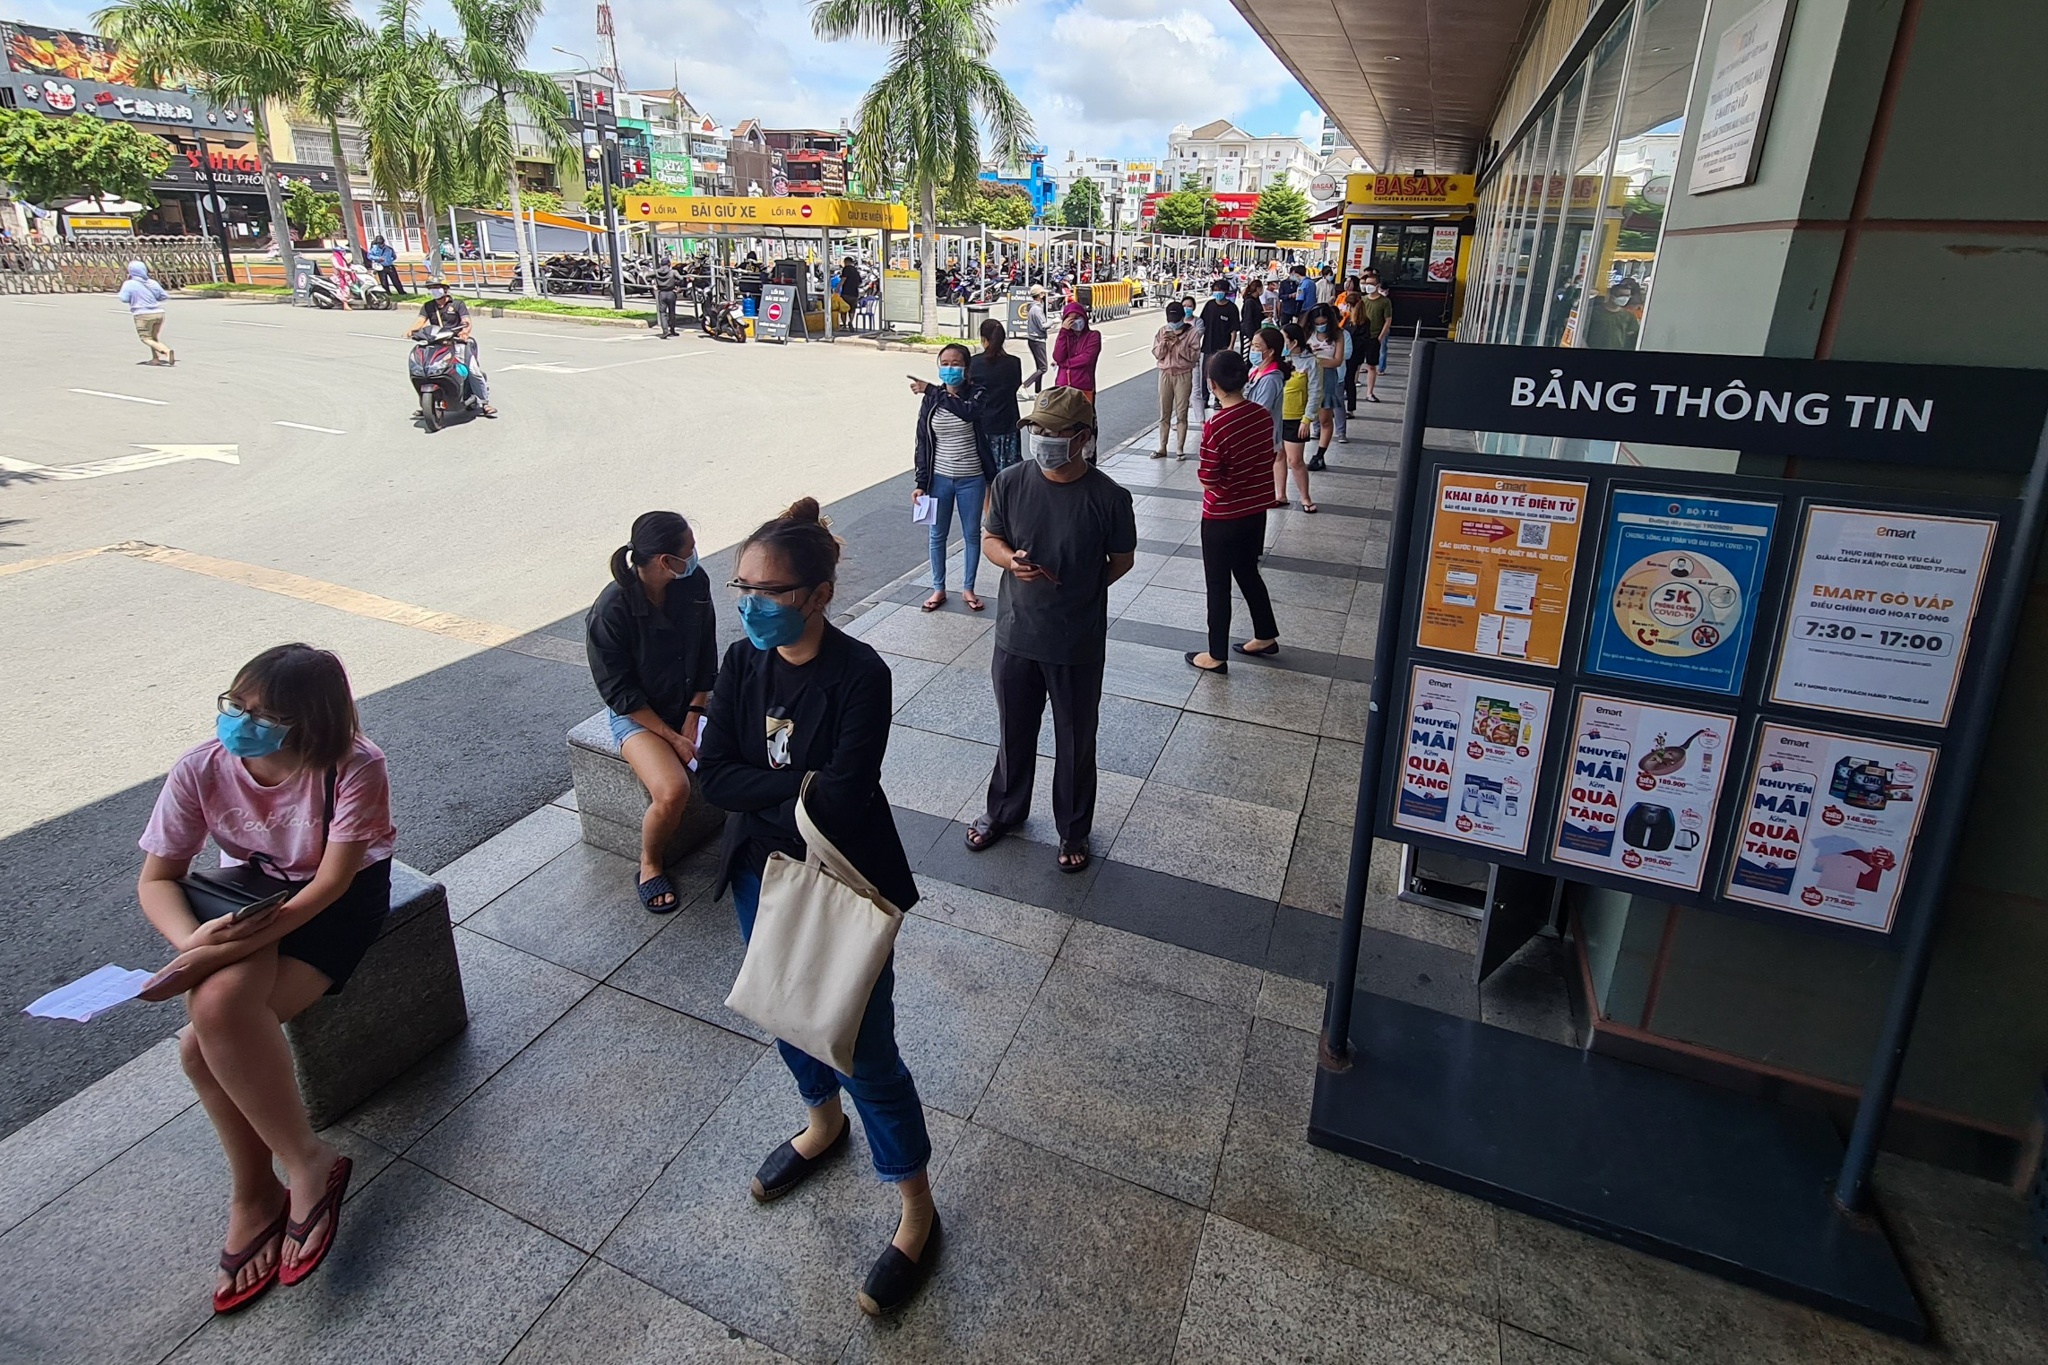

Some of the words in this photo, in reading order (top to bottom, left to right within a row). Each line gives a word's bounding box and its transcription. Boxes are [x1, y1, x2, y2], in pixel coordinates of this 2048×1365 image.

[1374, 176, 1449, 196] BASAX
[691, 202, 711, 217] BÃI
[714, 202, 737, 218] GIỮ
[740, 206, 757, 218] XE
[786, 208, 797, 216] RA
[1510, 369, 1637, 413] BẢNG
[1650, 379, 1830, 426] THÔNG
[1844, 395, 1934, 432] TIN
[1495, 480, 1528, 492] emart
[1445, 490, 1472, 502] KHAI
[1501, 496, 1509, 506] Y
[1512, 494, 1526, 507] TẾ
[1528, 498, 1556, 512] ĐIỆN
[1559, 499, 1576, 512] TỬ
[1686, 507, 1699, 516] BỘ
[1709, 508, 1720, 517] TẾ
[1876, 526, 1917, 539] emart
[1837, 554, 1861, 564] CÁCH
[1861, 557, 1873, 565] XÃ
[1874, 559, 1889, 567] HỘI
[1840, 549, 1863, 558] THỰC
[1863, 551, 1882, 559] HIỆN
[1883, 553, 1905, 561] THEO
[1906, 554, 1922, 563] YÊU
[1923, 555, 1942, 565] CẦU
[1663, 589, 1692, 604] 5K
[1812, 584, 1877, 603] EMART
[1880, 591, 1909, 606] GÒ
[1913, 592, 1954, 611] VẤP
[1653, 608, 1695, 619] COVID-19
[1834, 603, 1867, 613] CHỈNH
[1868, 606, 1886, 616] GIỜ
[1887, 610, 1917, 622] HOẠT
[1918, 613, 1950, 623] ĐỘNG
[1805, 621, 1856, 641] 7:30
[1880, 630, 1943, 652] 17:00
[1428, 678, 1453, 689] emart
[1596, 706, 1622, 717] emart
[1414, 715, 1457, 731] KHUYẾN
[1411, 729, 1455, 751] MÃI
[1780, 737, 1810, 749] emart
[1578, 745, 1627, 761] KHUYẾN
[1408, 756, 1450, 775] QUÀ
[1575, 760, 1624, 783] MÃI
[1406, 773, 1448, 791] TẶNG
[1759, 777, 1812, 794] KHUYẾN
[1571, 787, 1618, 808] QUÀ
[1754, 793, 1809, 817] MÃI
[1569, 805, 1615, 824] TẶNG
[1749, 821, 1800, 844] QUÀ
[1745, 841, 1797, 860] TẶNG
